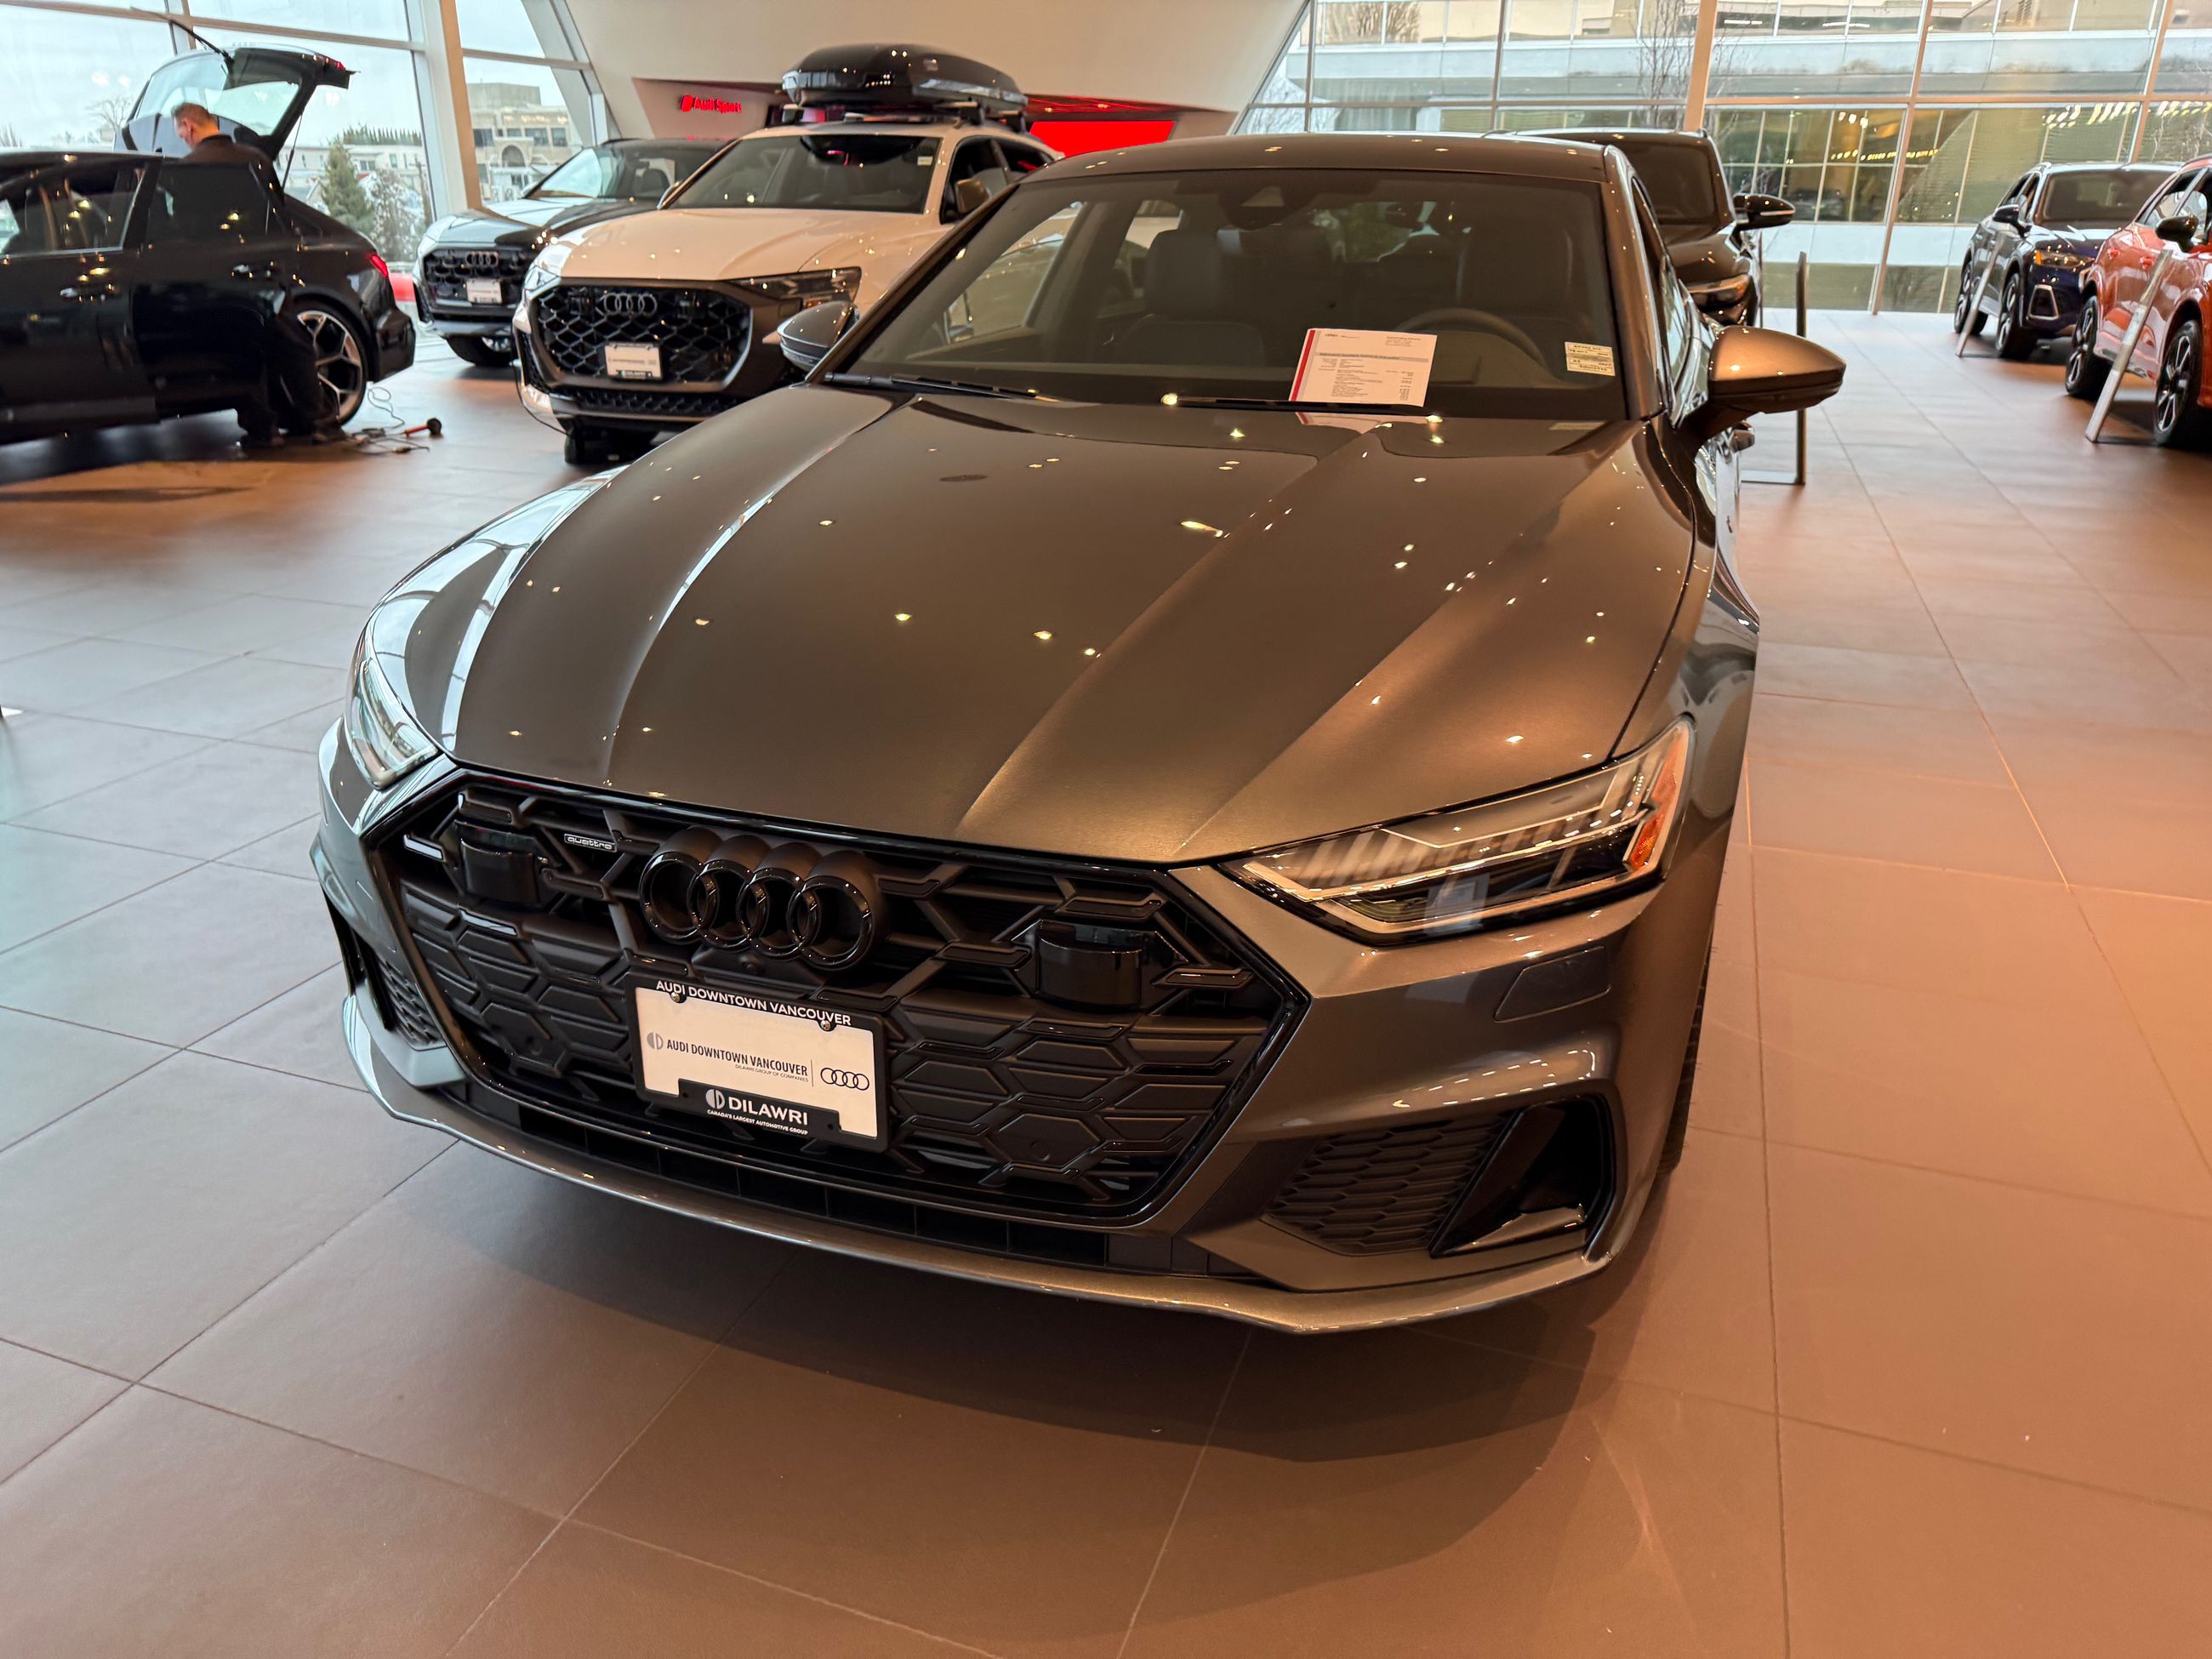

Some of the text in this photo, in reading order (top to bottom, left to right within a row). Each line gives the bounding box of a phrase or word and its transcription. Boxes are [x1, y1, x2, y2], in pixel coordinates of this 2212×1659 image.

[567, 836, 613, 850] quattro
[656, 980, 852, 1026] AUDI DOWNTOWN VANCOUVER
[667, 1039, 808, 1077] AUDI DOWNTOWN VANCOUVER
[728, 1096, 808, 1126] DILAWRI
[733, 1114, 755, 1124] LARGEST
[755, 1119, 790, 1132] AUTOMOTIVE
[789, 1126, 808, 1136] GROUP
